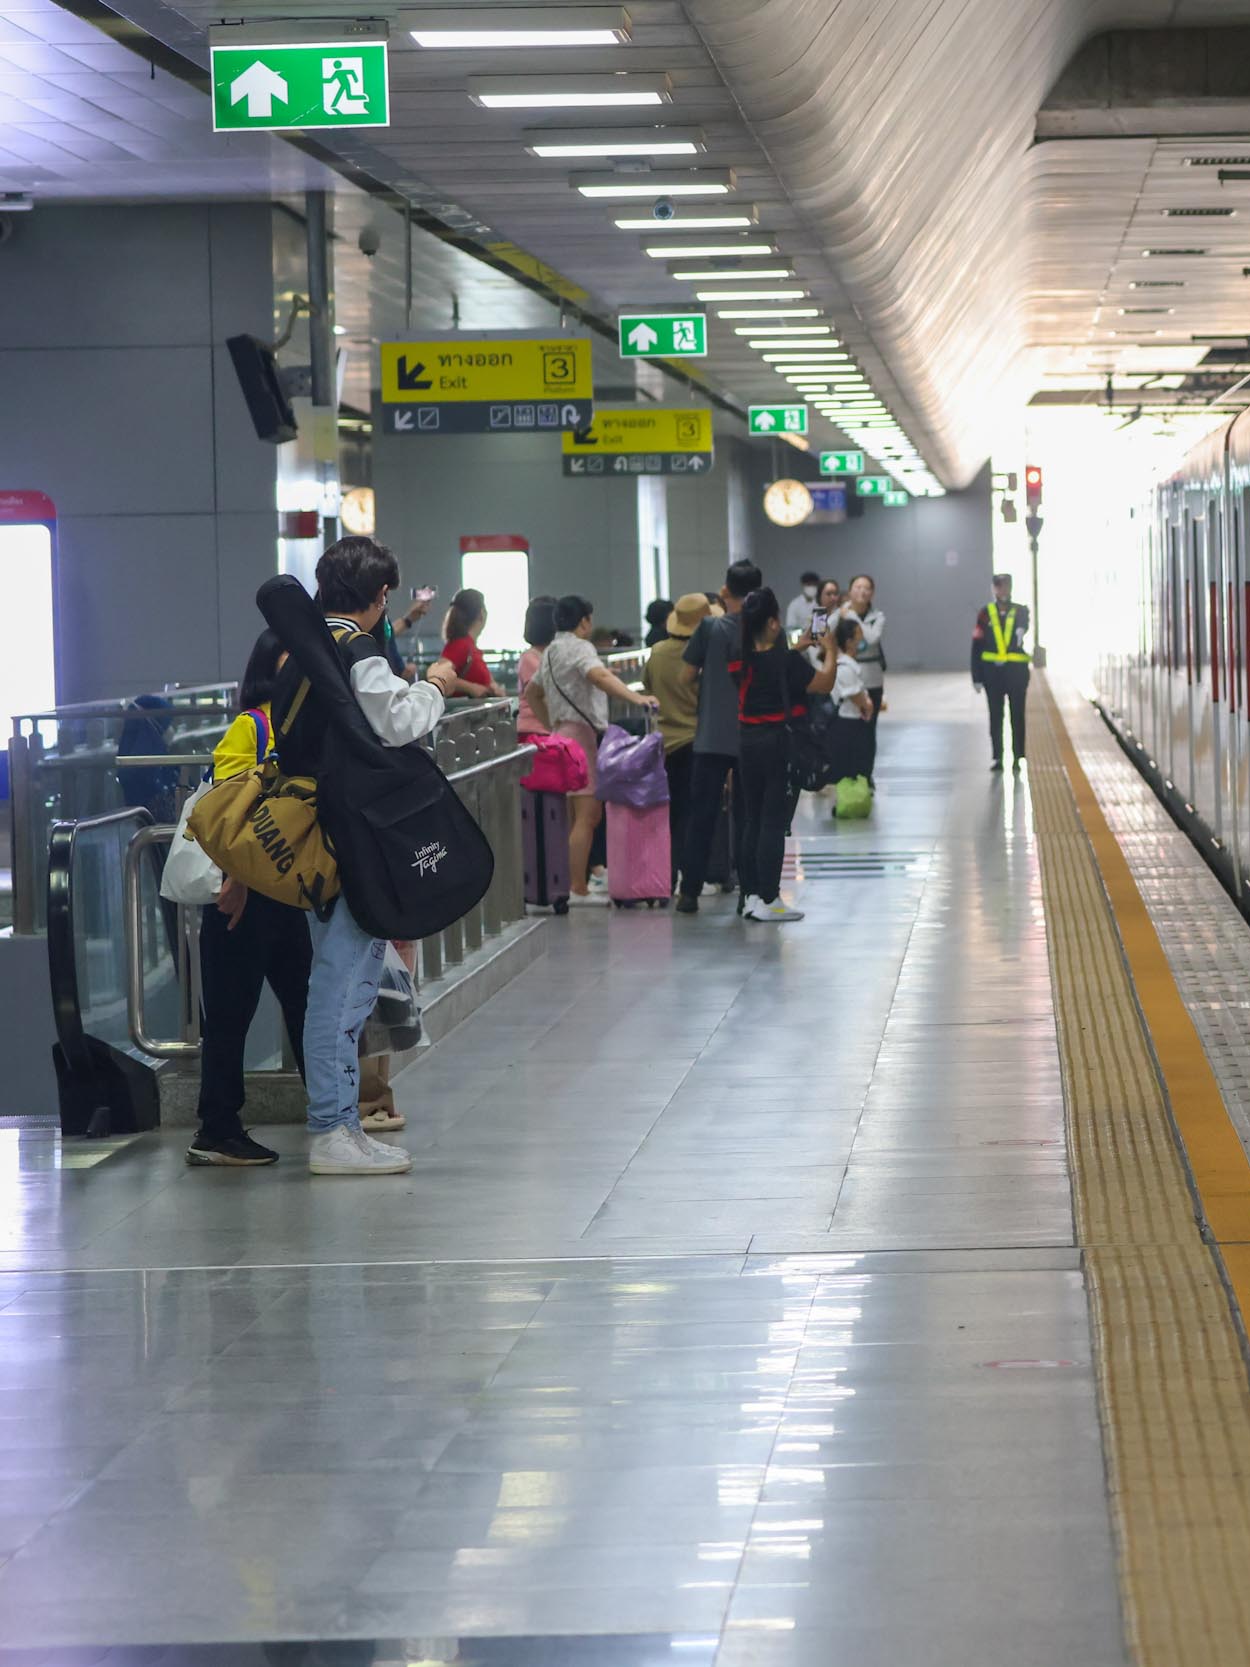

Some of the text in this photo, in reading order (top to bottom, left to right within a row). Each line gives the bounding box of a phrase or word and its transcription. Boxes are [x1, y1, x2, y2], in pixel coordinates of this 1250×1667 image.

[438, 353, 513, 367] ทางออก
[551, 358, 569, 378] 3
[439, 376, 468, 389] Exit
[681, 420, 696, 437] 3
[414, 841, 440, 860] Infinity
[411, 846, 448, 877] Tagima
